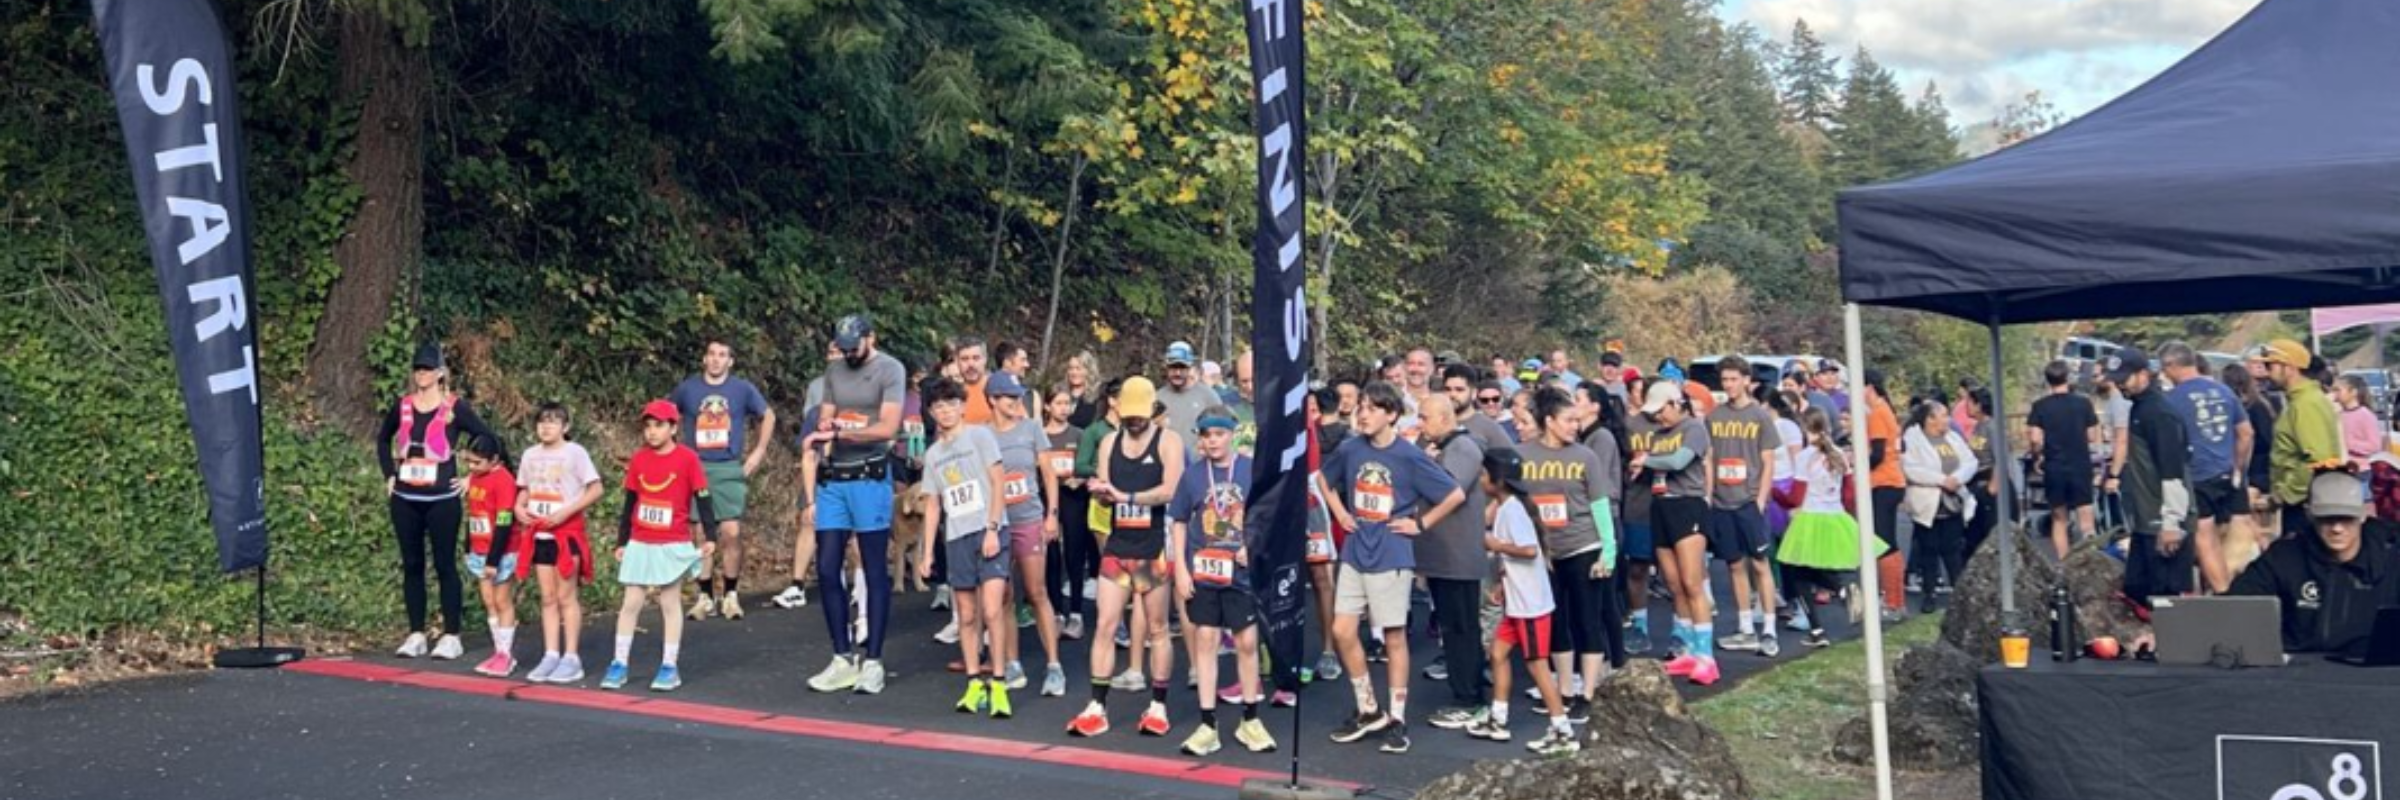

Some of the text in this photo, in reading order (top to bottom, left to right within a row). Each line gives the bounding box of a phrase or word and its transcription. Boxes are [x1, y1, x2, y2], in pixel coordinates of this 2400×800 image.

[136, 57, 258, 406] START
[1250, 0, 1309, 473] FINISH
[642, 506, 664, 522] 101
[950, 484, 974, 506] 187
